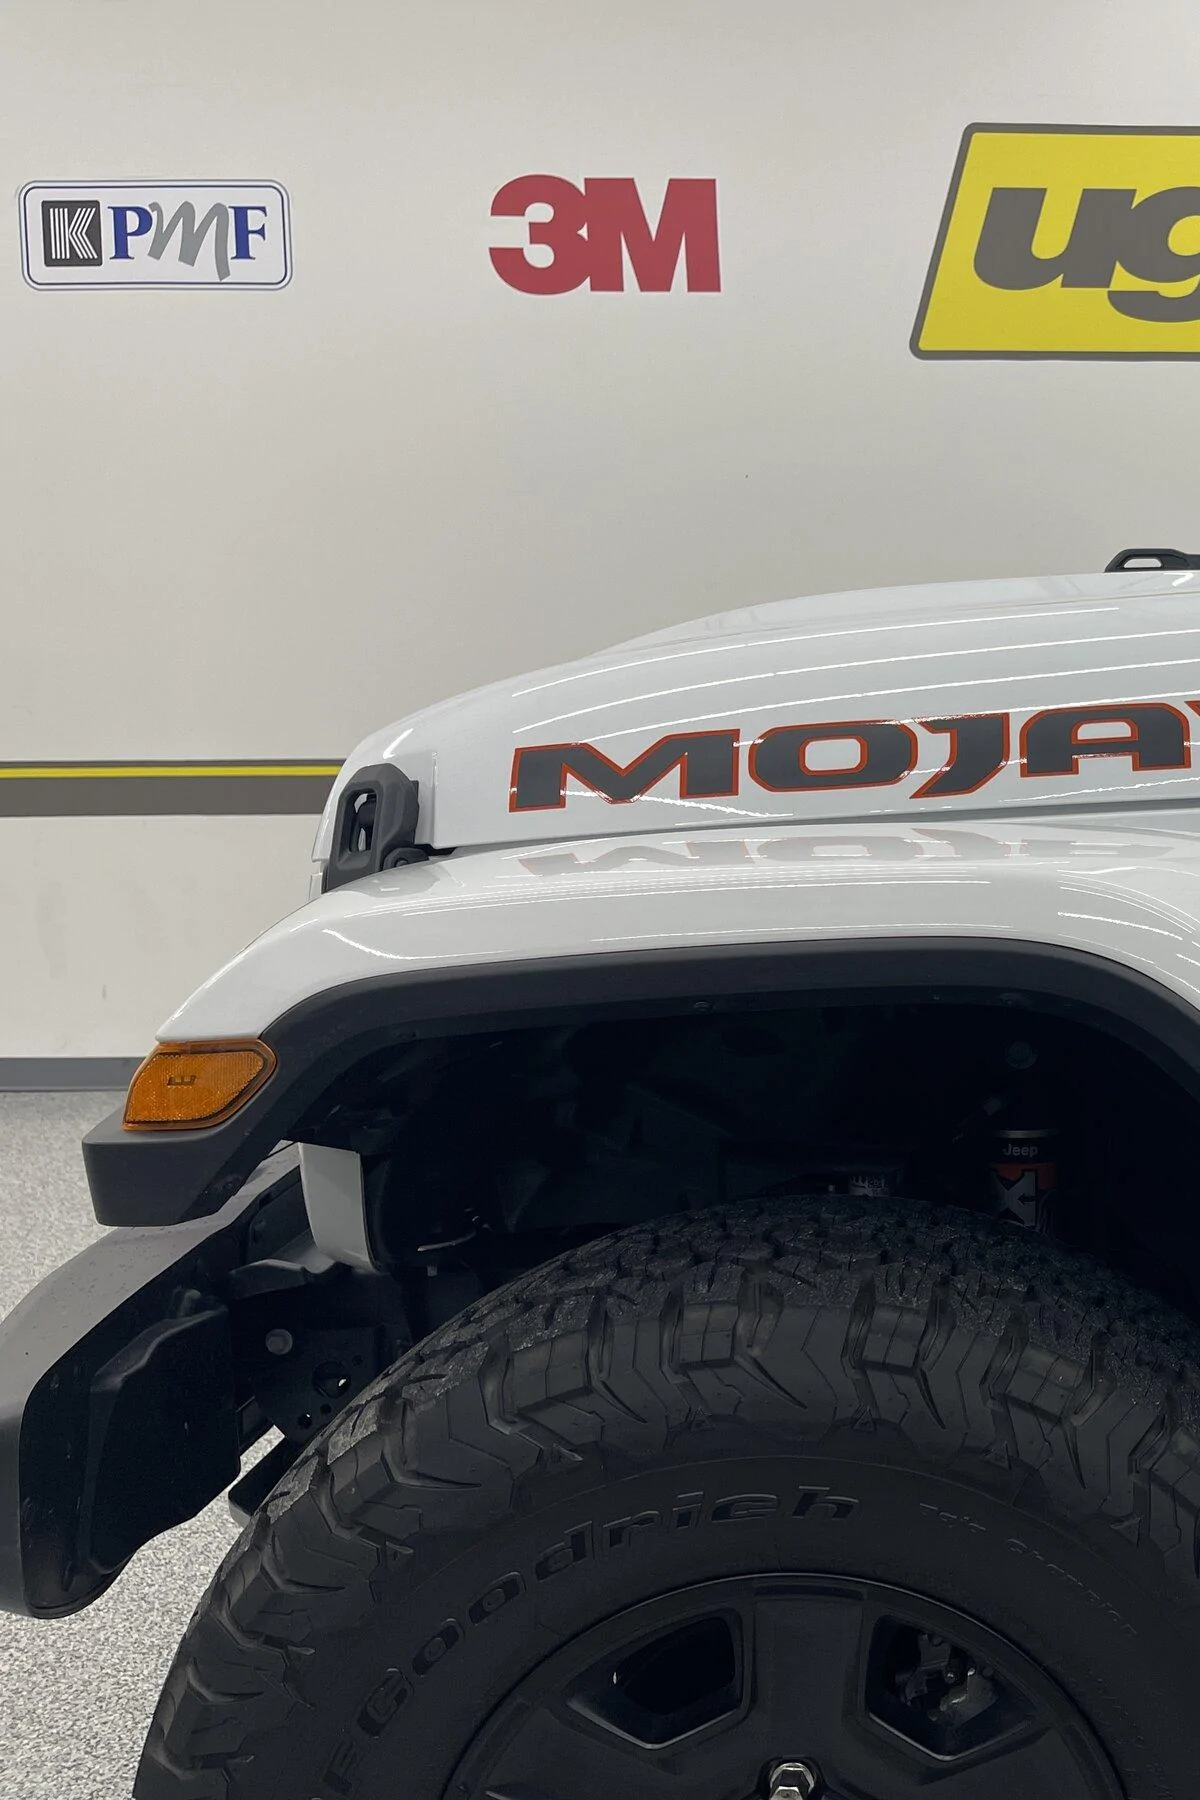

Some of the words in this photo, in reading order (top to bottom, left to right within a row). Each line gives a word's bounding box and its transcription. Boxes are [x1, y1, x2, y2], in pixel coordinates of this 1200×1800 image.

[489, 174, 722, 295] 3M
[1002, 1143, 1039, 1158] Jeep
[311, 1485, 859, 1800] FGoodrich
